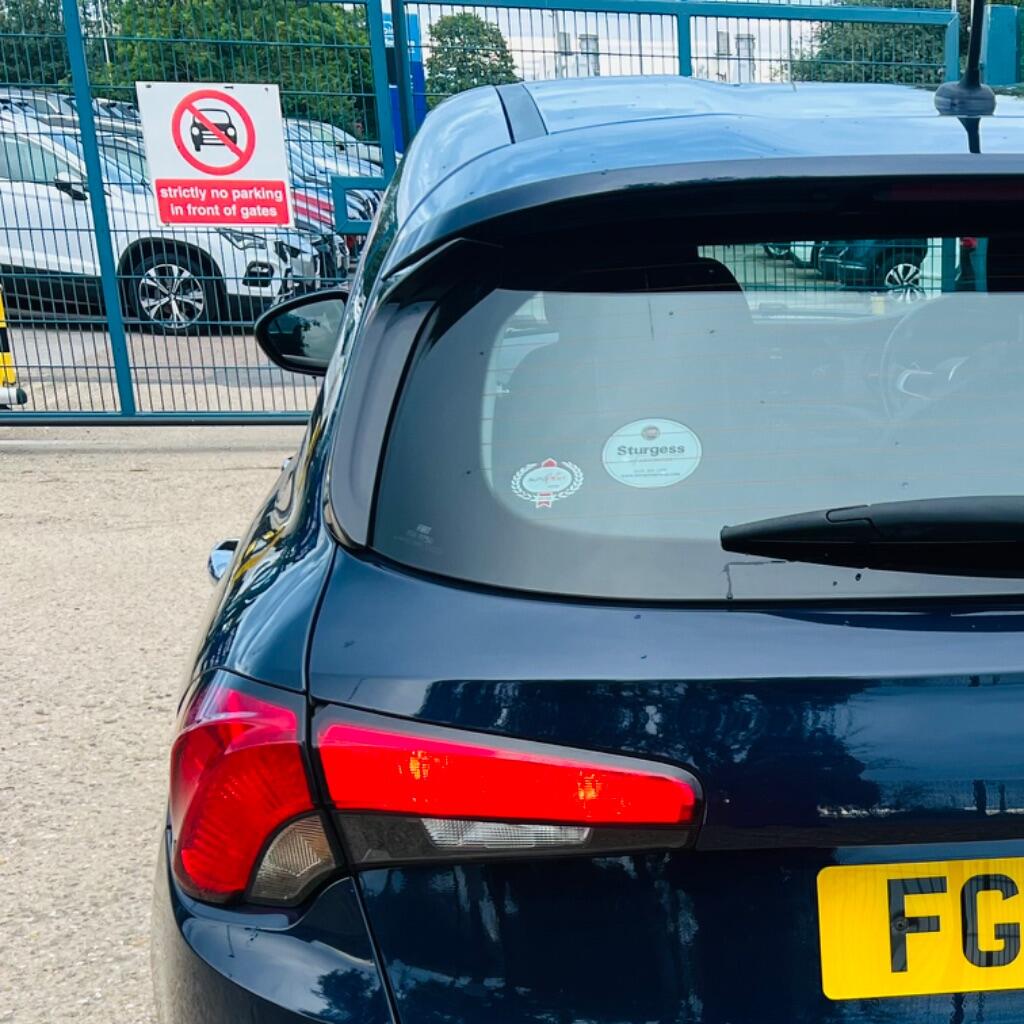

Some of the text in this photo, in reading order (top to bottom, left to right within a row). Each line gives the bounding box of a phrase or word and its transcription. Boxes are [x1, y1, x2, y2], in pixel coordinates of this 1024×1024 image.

[160, 186, 283, 202] strictly no parking
[170, 203, 278, 219] in front of gates
[617, 445, 685, 457] Sturgess
